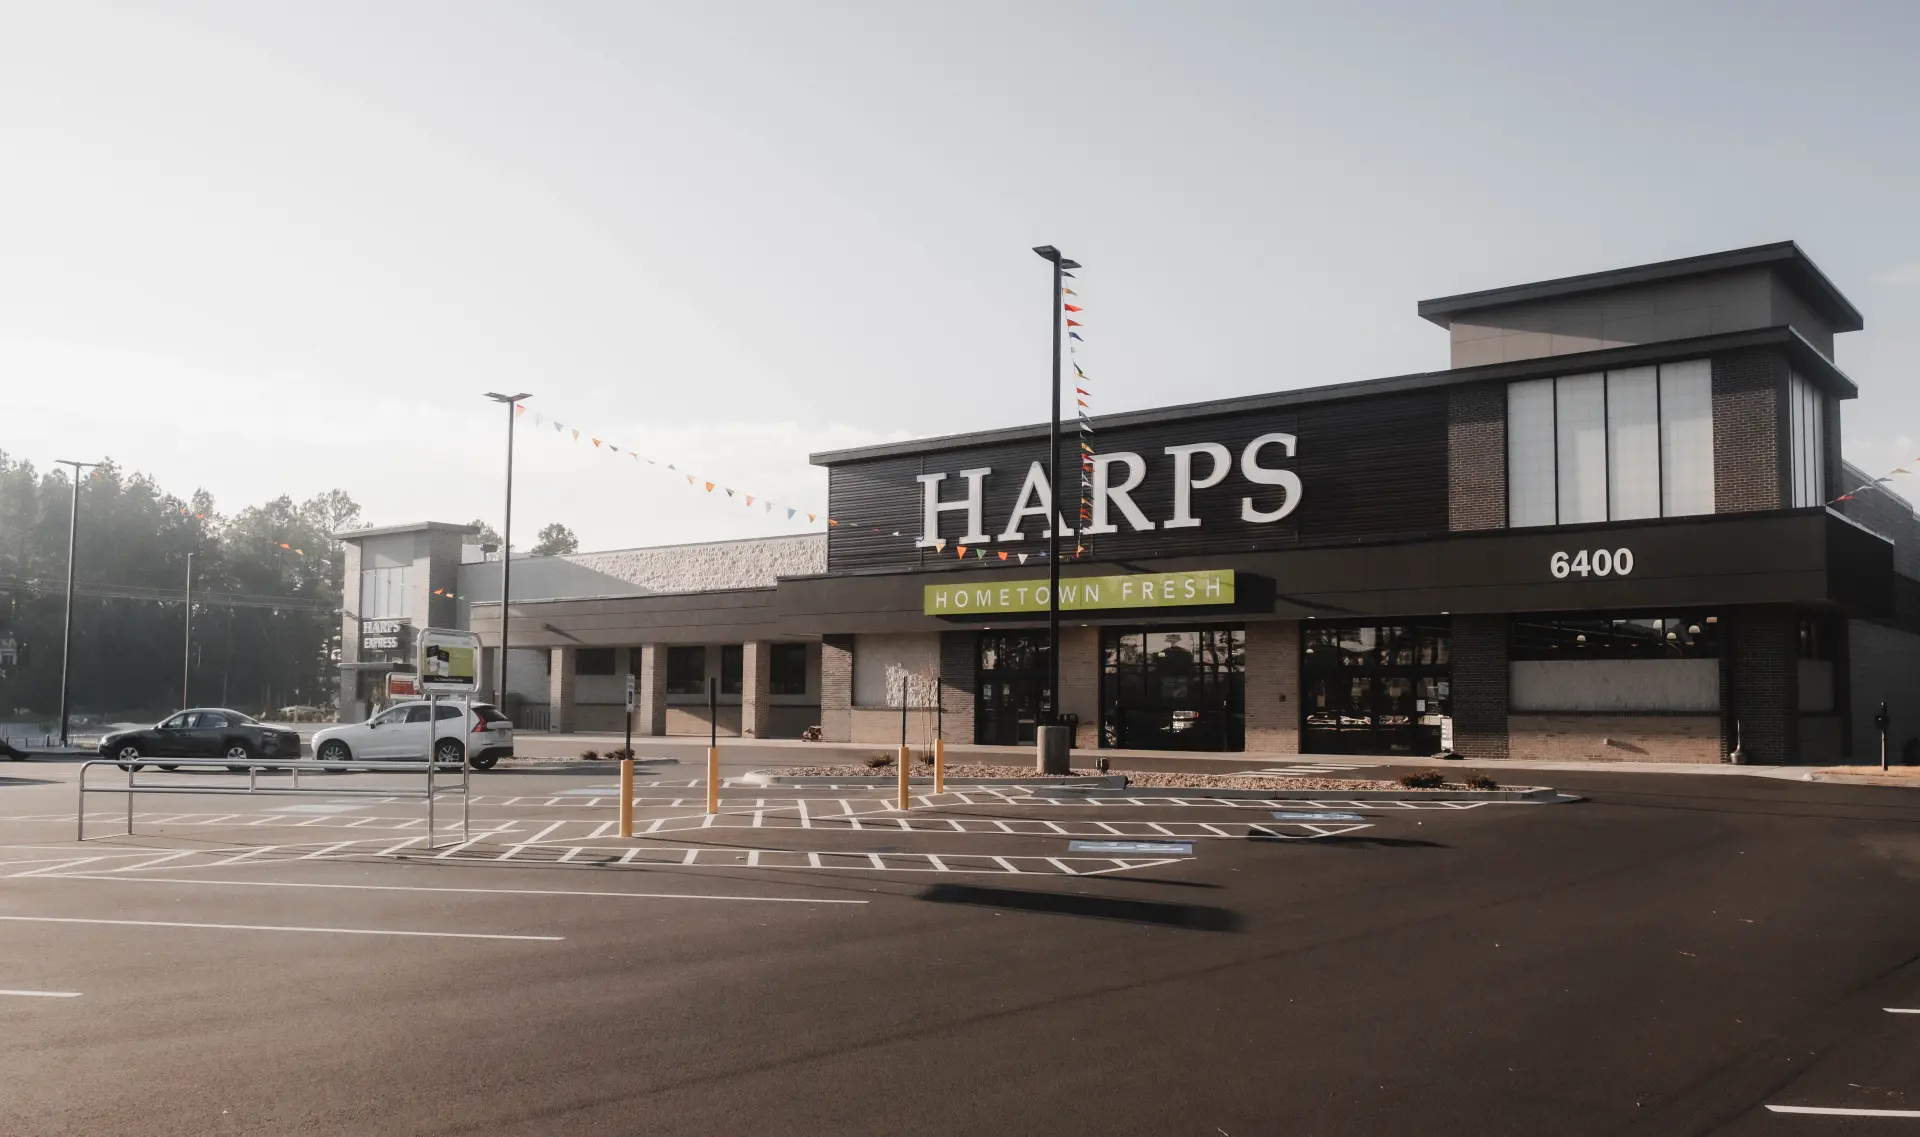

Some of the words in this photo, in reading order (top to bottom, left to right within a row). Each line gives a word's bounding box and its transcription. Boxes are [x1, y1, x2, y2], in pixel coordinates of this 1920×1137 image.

[916, 432, 1303, 548] HARPS
[1550, 547, 1634, 579] 6400
[936, 584, 1100, 609] HOMETOWN
[1122, 577, 1220, 602] FRESH
[363, 620, 401, 634] HARPS
[363, 637, 399, 649] EXPRESS
